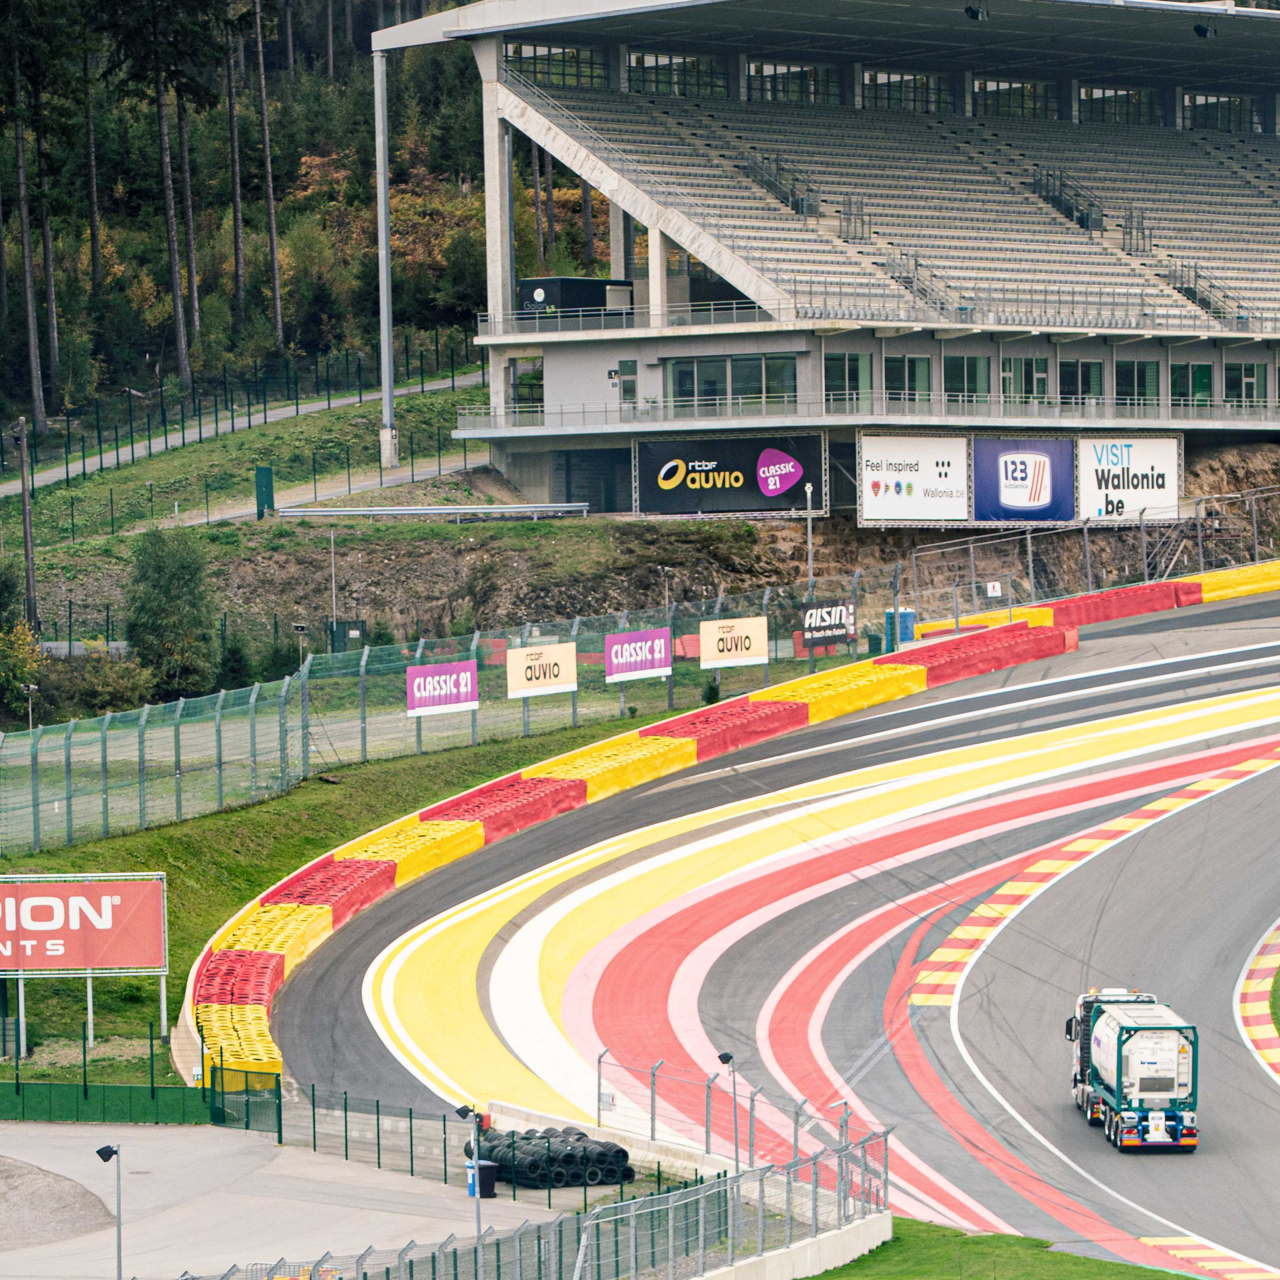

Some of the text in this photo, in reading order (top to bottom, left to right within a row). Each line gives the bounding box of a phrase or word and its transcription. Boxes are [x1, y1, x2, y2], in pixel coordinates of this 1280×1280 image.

[1092, 444, 1133, 466] VISIT
[759, 462, 796, 478] CLASSIC
[865, 459, 920, 473] Feel inspired
[1004, 460, 1028, 481] 123
[686, 470, 744, 489] auvio
[767, 477, 781, 491] 21
[1094, 465, 1166, 490] Wallonia
[1097, 493, 1125, 517] .be
[804, 605, 847, 628] AISIN
[611, 638, 665, 665] CLASSIC 21
[717, 635, 752, 653] auvio
[524, 661, 560, 682] auvio
[413, 671, 472, 697] CLASSIC 21
